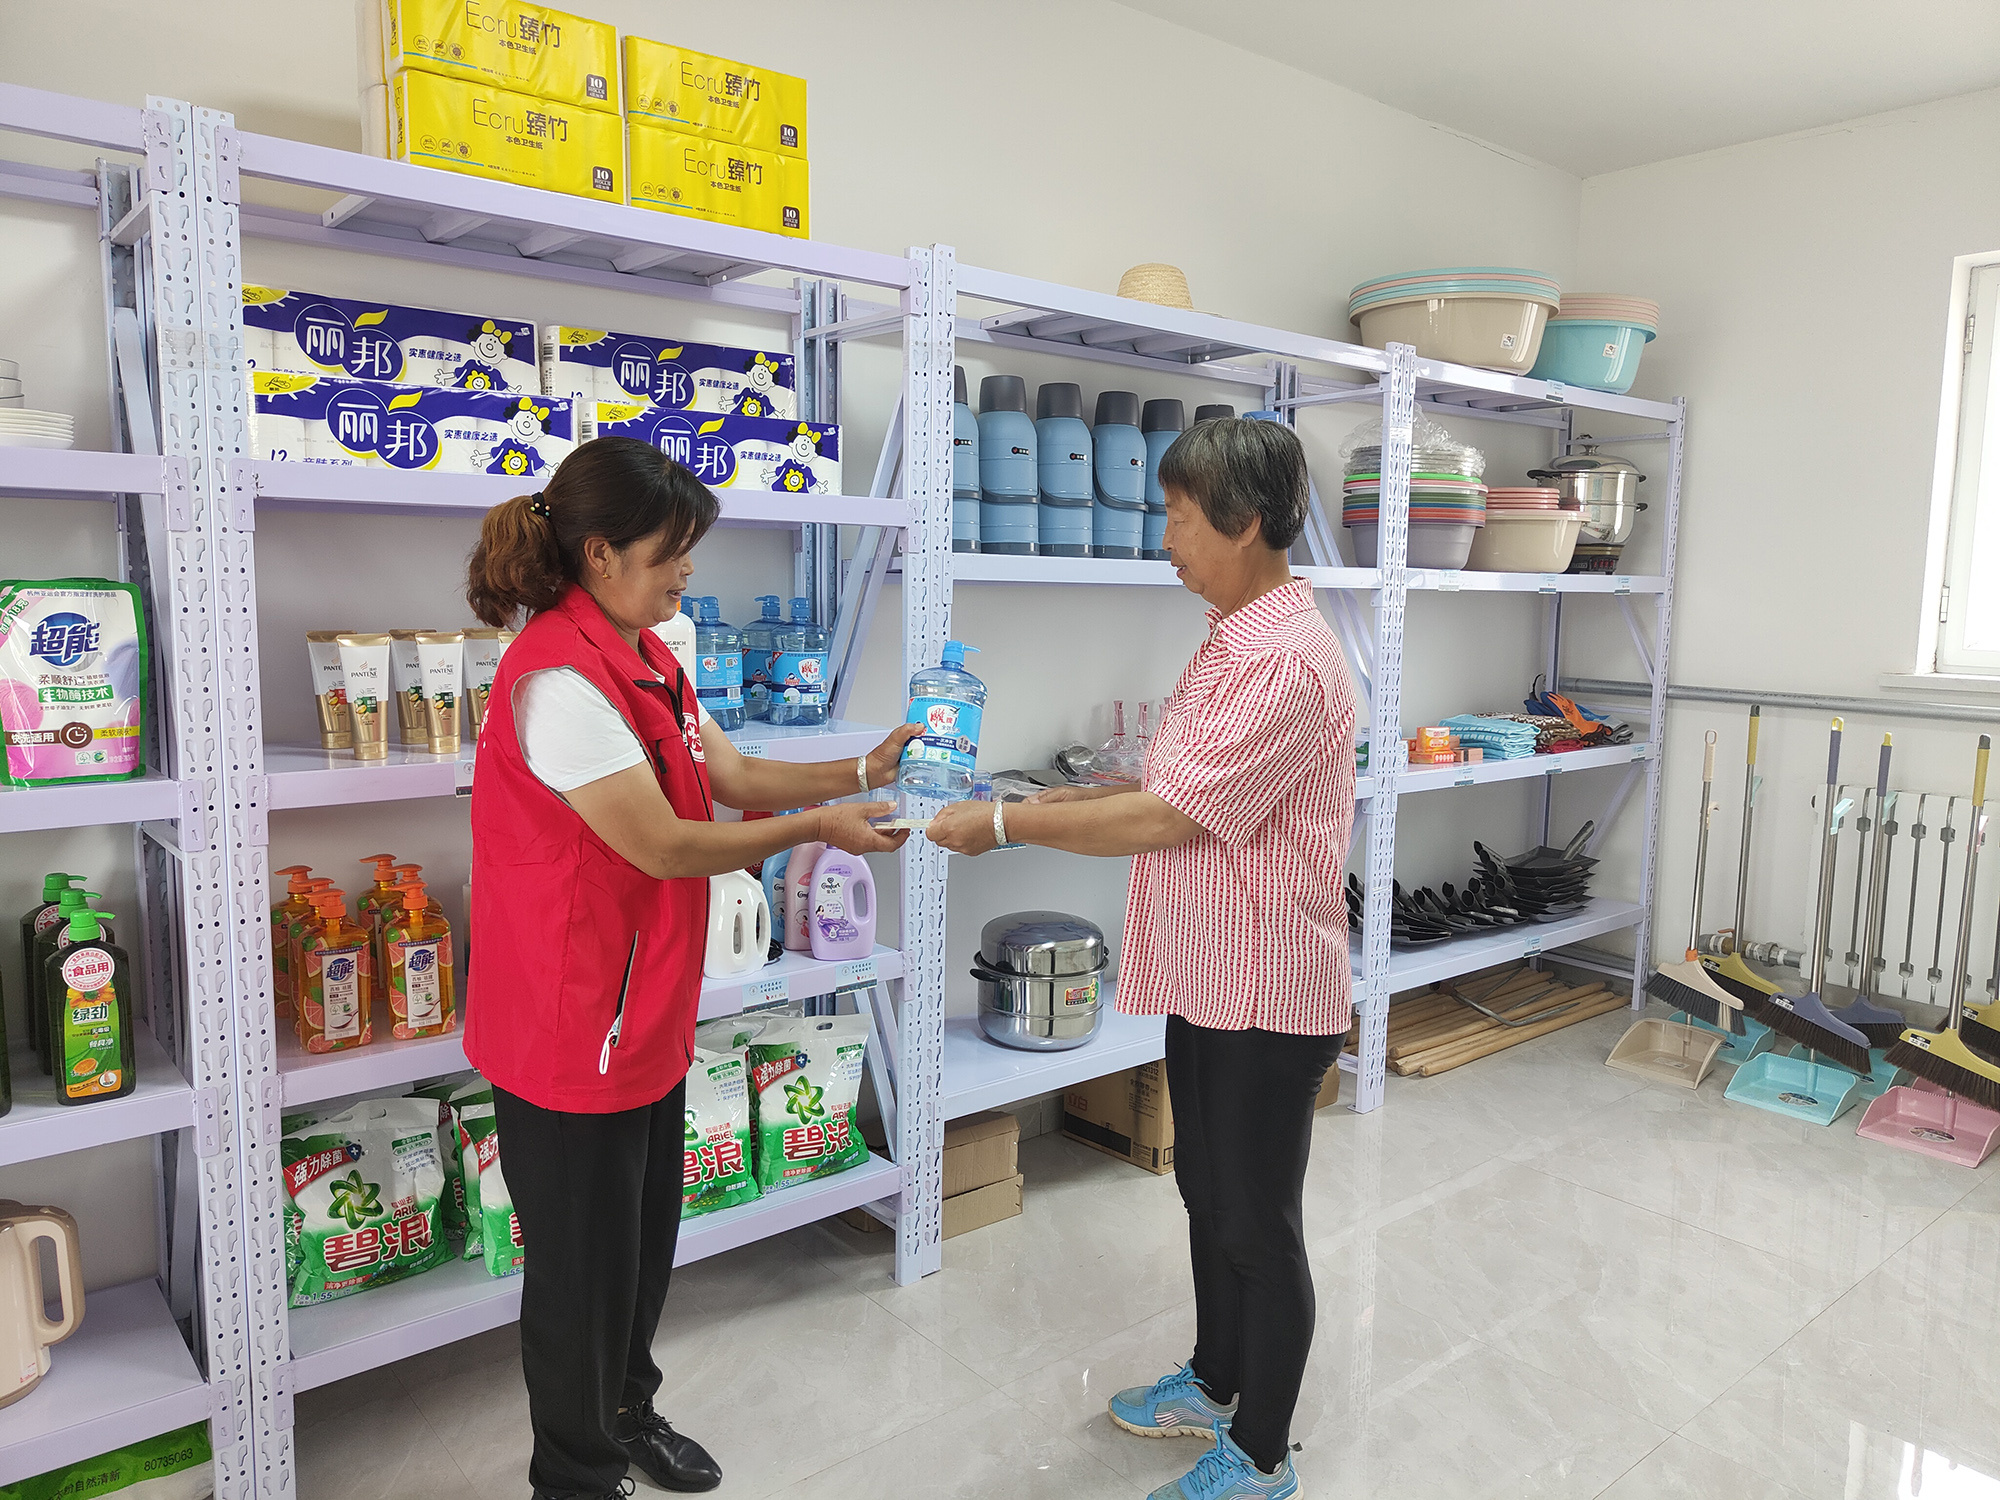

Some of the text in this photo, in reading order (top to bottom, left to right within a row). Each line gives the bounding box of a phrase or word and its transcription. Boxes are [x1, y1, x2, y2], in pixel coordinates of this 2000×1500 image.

[498, 39, 537, 56] 本色卫生纸
[590, 77, 603, 89] 10
[708, 95, 740, 109] 本色卫生纸
[784, 126, 795, 138] 10
[505, 135, 543, 150] 本色卫生纸
[595, 168, 609, 181] 10
[710, 180, 742, 193] 本色卫生纸
[785, 208, 797, 220] 10
[305, 316, 394, 377] 丽邦
[408, 347, 463, 363] 实惠健康之选
[620, 353, 687, 404] 丽邦
[699, 378, 740, 391] 实惠健康之选
[337, 402, 429, 462] 丽邦
[444, 428, 499, 443] 实惠健康之选
[659, 427, 729, 479] 丽邦
[740, 450, 782, 463] 实惠健康之选
[29, 621, 101, 663] 超能
[41, 687, 110, 701] 生物酶技术
[408, 949, 436, 971] 超能
[72, 961, 110, 977] 食品用
[326, 958, 355, 980] 超能
[73, 1003, 109, 1023] 绿劲
[707, 1130, 735, 1145] ARIEL
[293, 1149, 344, 1188] 强力除菌
[324, 1211, 435, 1273] 碧浪
[312, 1290, 333, 1302] 1.55
[144, 1447, 194, 1472] 80735063
